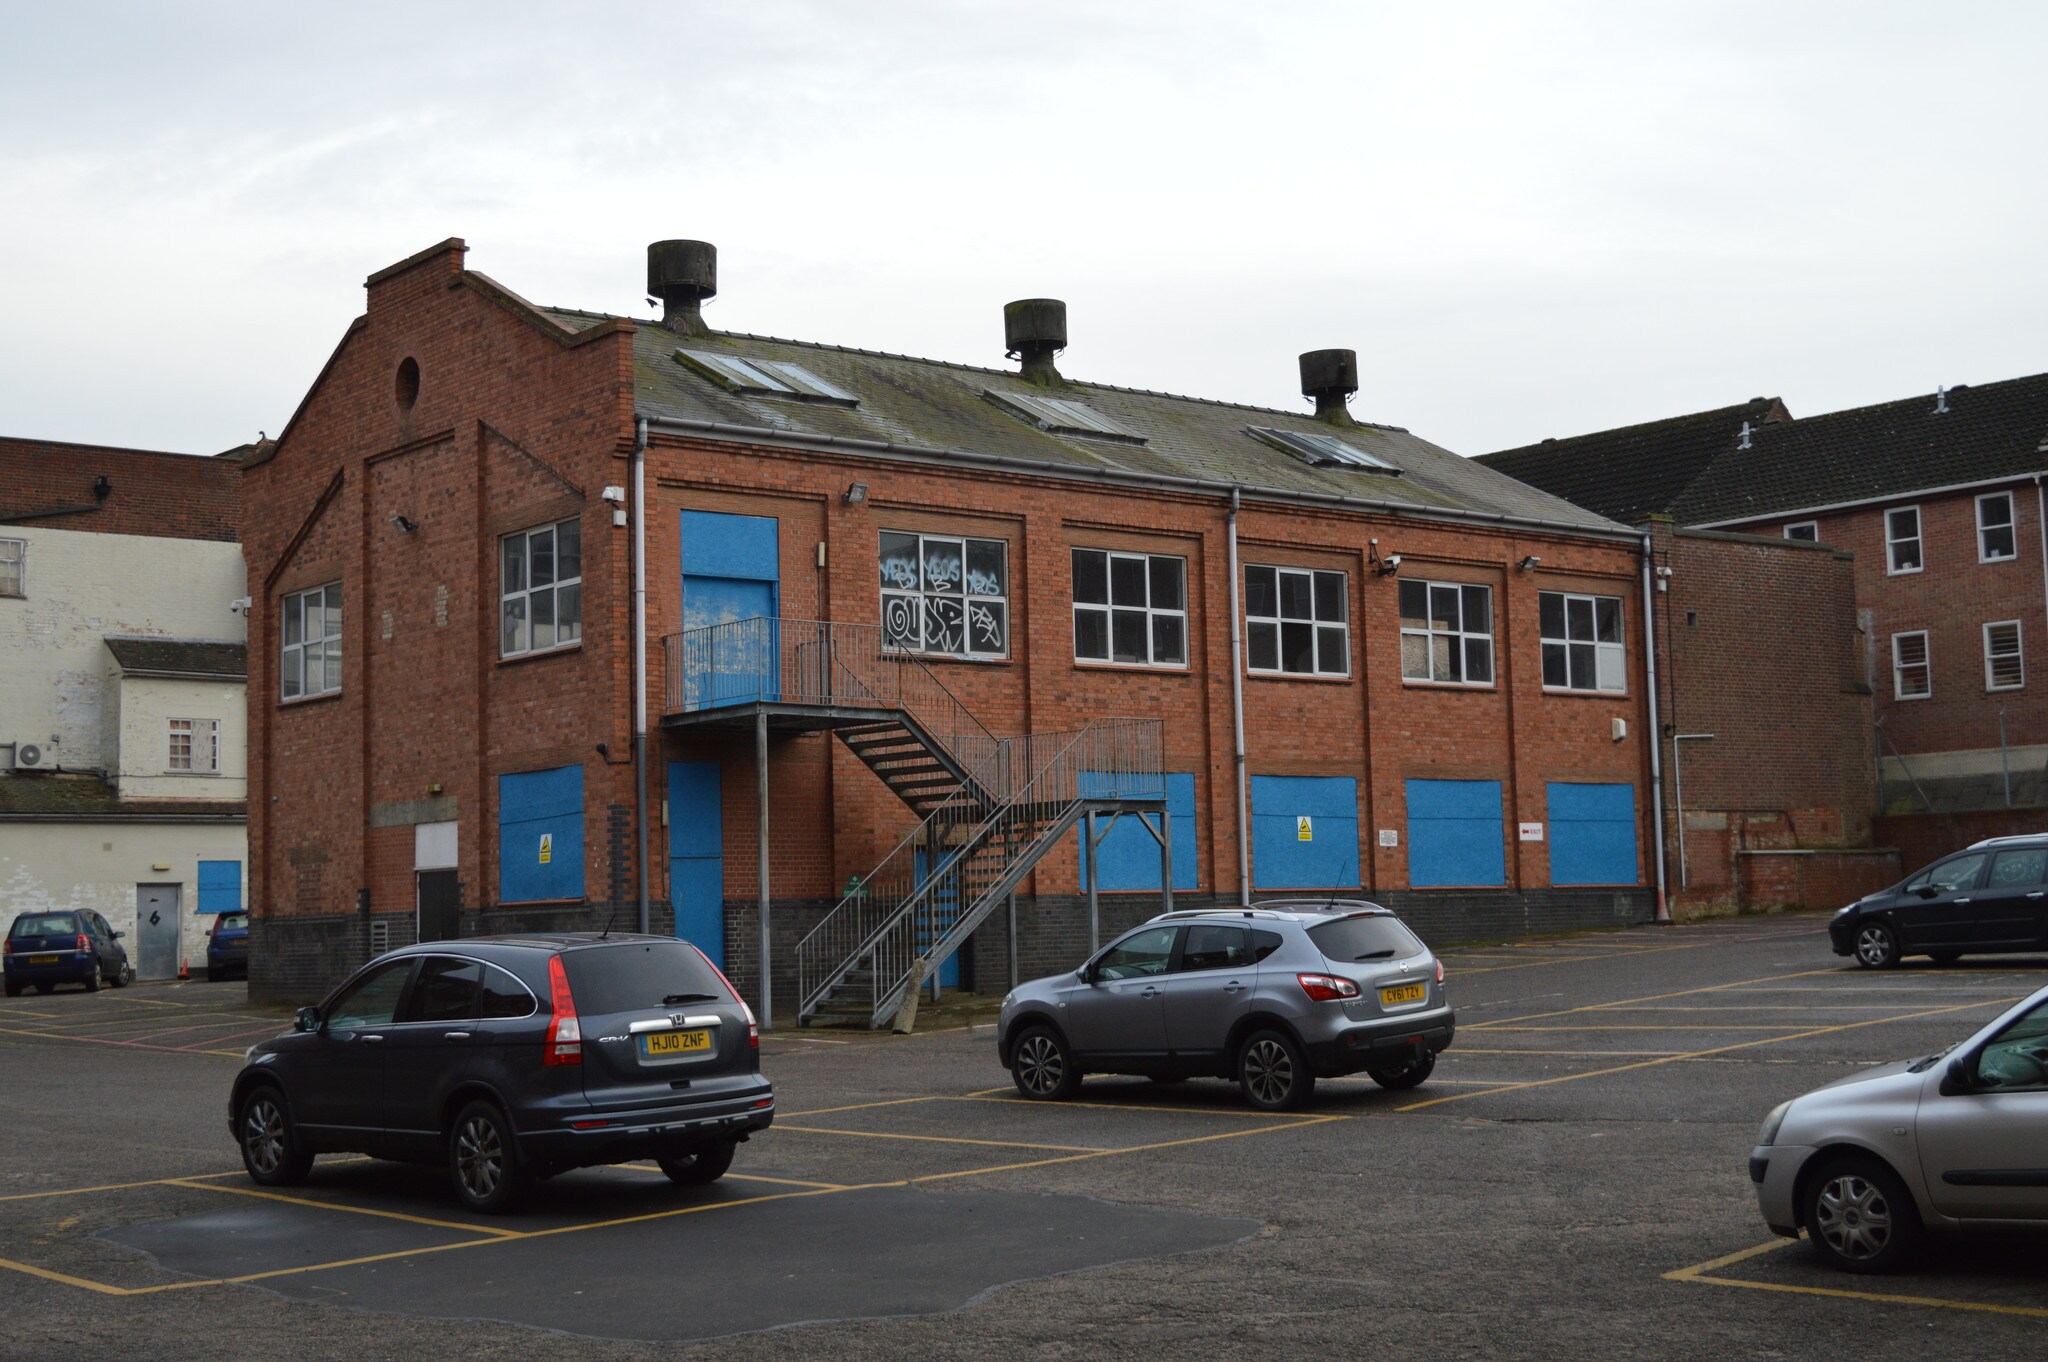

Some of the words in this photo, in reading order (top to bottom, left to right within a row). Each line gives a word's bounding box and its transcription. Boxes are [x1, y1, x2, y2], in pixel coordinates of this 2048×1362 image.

[1405, 985, 1419, 998] TZY
[652, 1034, 680, 1050] HJ10
[682, 1033, 704, 1048] ZNF
